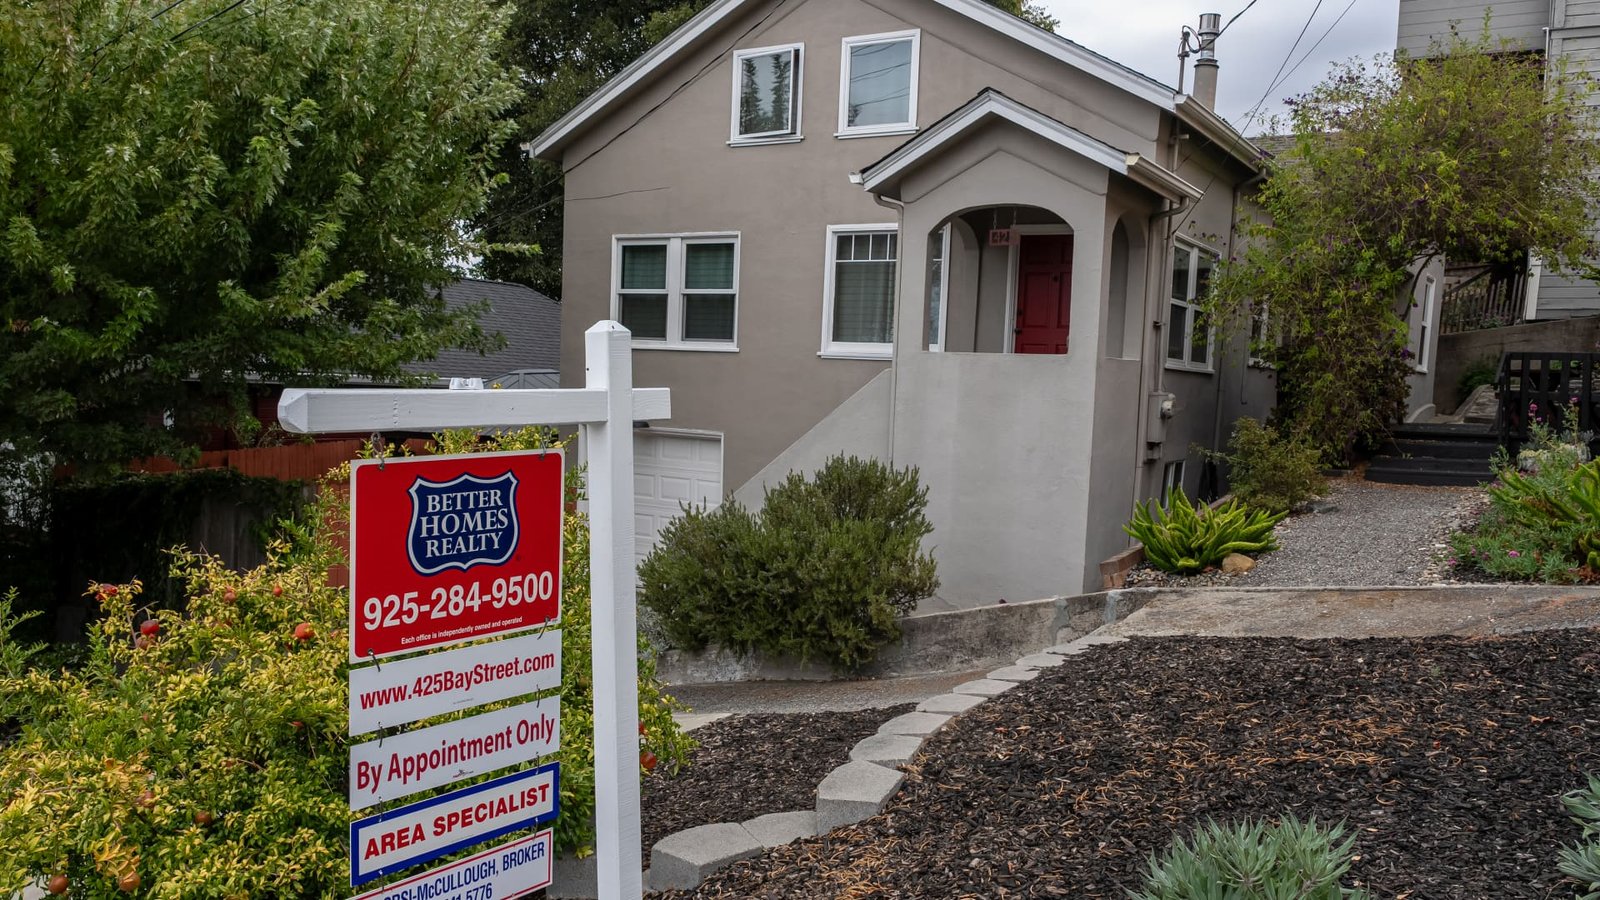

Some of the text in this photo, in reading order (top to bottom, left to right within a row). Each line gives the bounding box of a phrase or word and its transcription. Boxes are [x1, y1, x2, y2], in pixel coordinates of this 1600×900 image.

[420, 508, 508, 538] HOMES
[426, 489, 504, 513] BETTER
[425, 531, 503, 558] REALTY
[363, 570, 553, 631] 925-284-9500
[401, 635, 415, 645] Each
[416, 633, 431, 642] office
[438, 625, 474, 638] independently
[474, 622, 491, 631] owned
[491, 620, 501, 628] and
[501, 615, 523, 627] operated
[360, 653, 555, 710] www.425BayStreet.com
[357, 713, 555, 794] By Appointment Only
[364, 783, 550, 860] AREA SPECIALIST
[384, 841, 545, 900] SI-McCULLOUGH, BROKER
